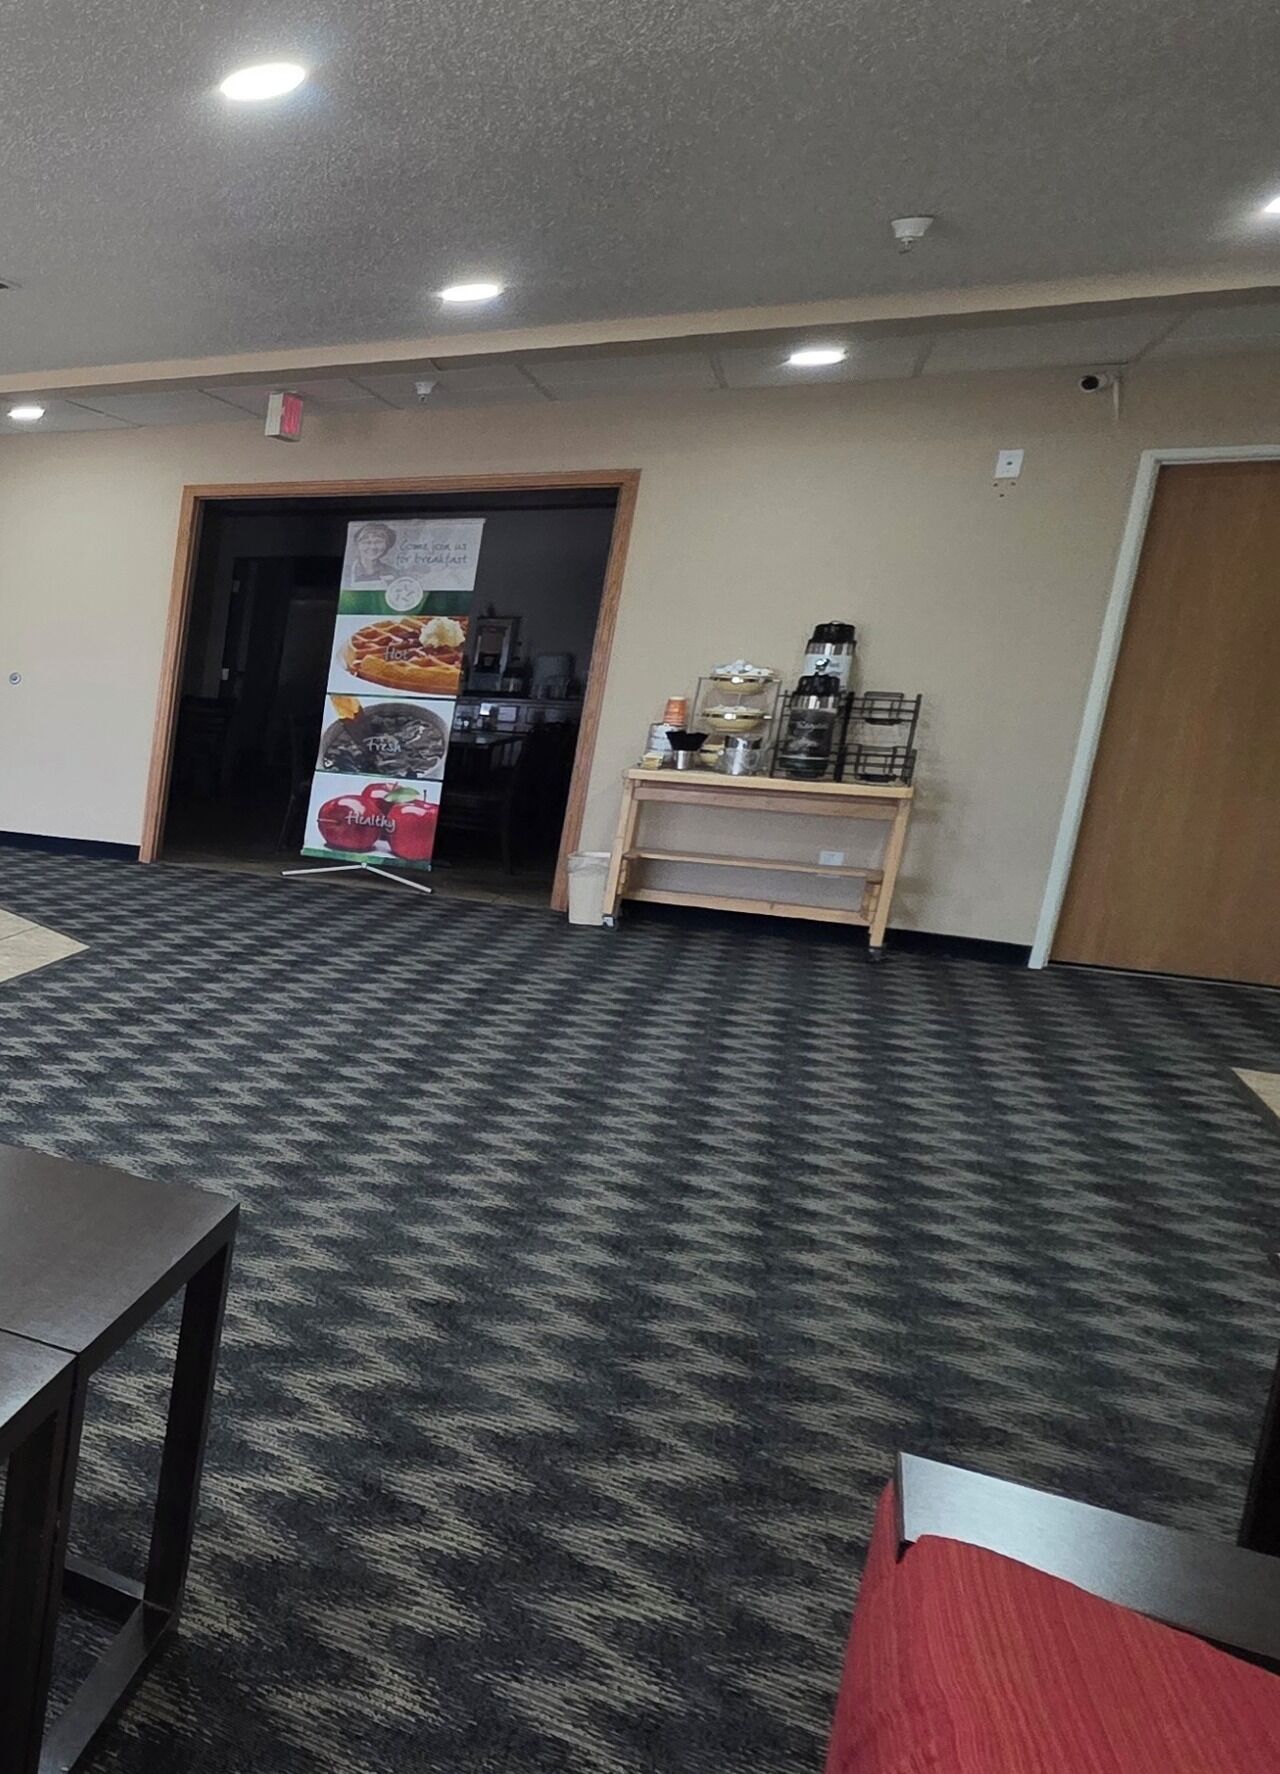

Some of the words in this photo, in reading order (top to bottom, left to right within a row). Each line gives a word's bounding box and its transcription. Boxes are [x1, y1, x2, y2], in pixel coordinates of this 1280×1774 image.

[384, 645, 409, 661] Hot
[364, 735, 402, 753] Fresh
[344, 810, 396, 833] Healthy
